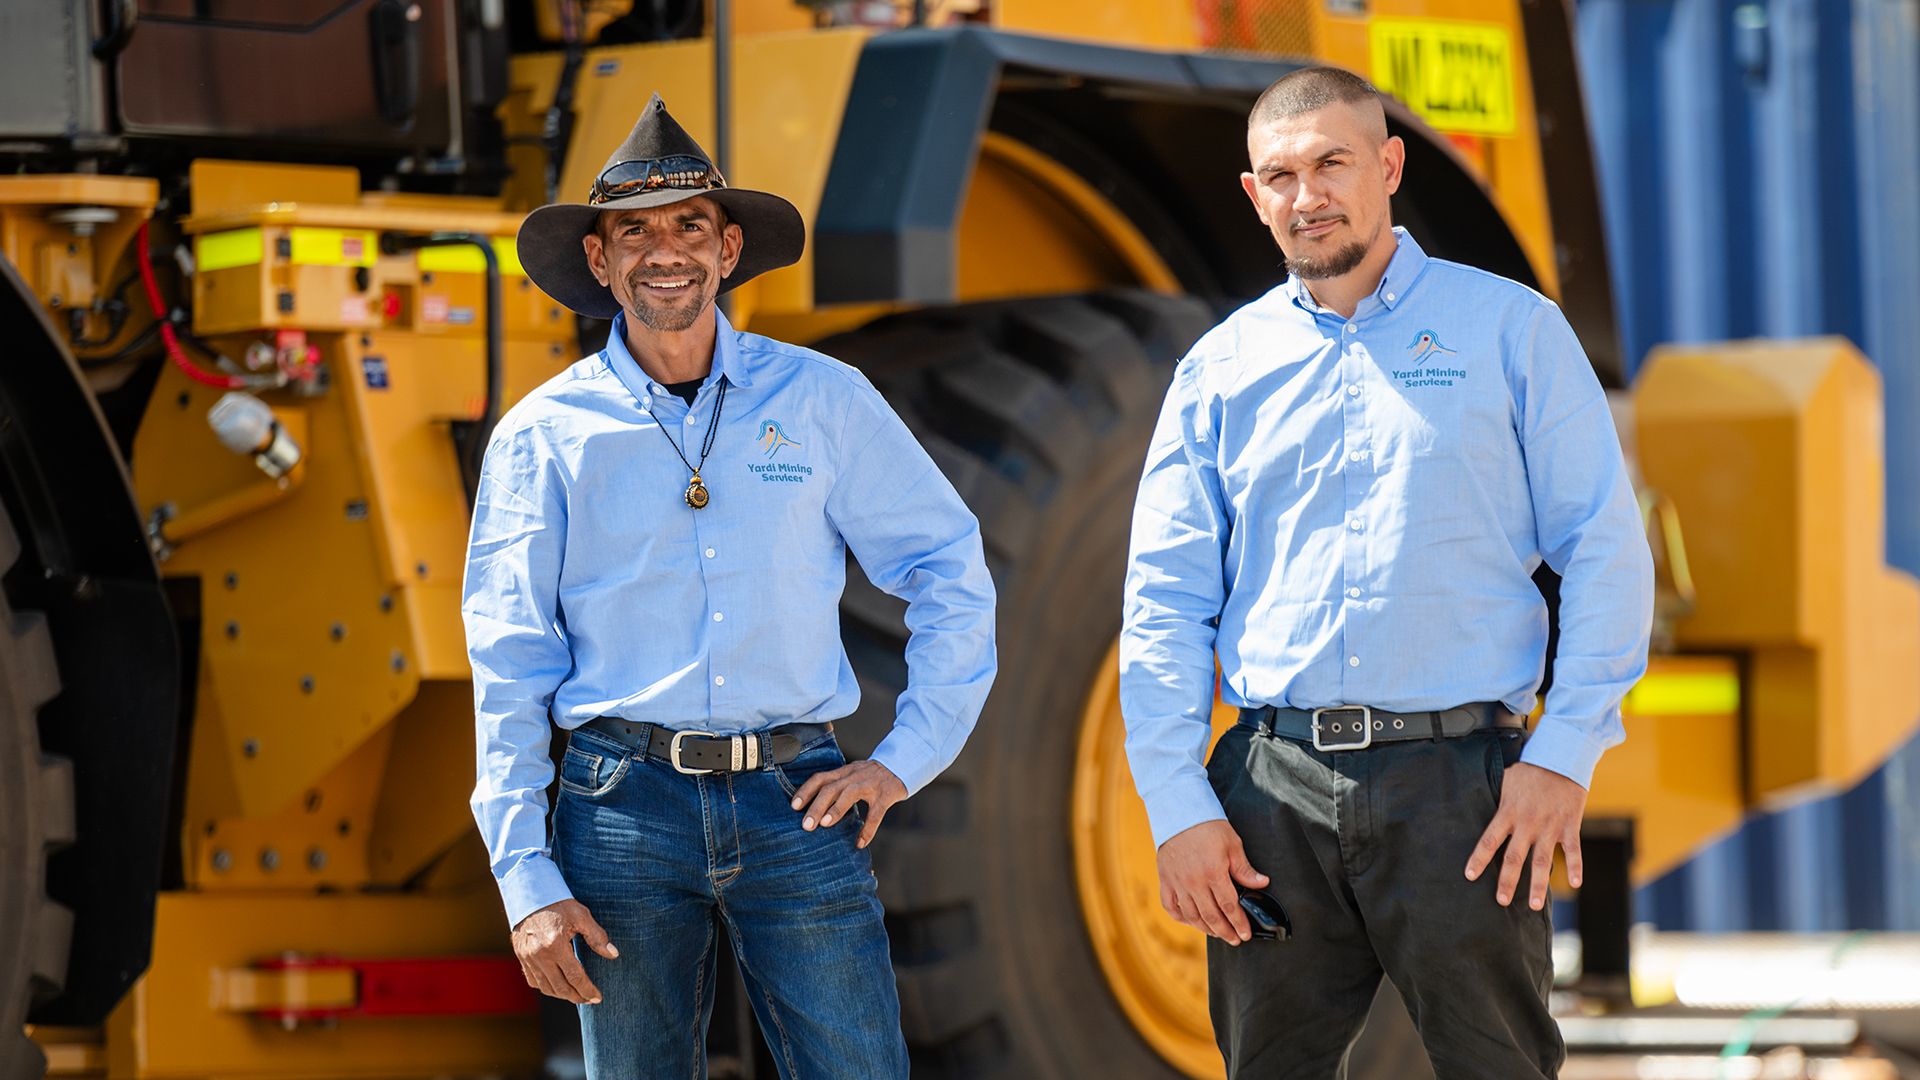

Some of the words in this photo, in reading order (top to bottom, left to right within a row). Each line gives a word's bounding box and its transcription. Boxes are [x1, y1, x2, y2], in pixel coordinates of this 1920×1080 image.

[1392, 368, 1423, 379] Yardi
[1426, 367, 1467, 379] Mining
[1405, 378, 1453, 388] Services
[747, 463, 776, 473] Yardi
[778, 463, 812, 475] Mining
[761, 473, 804, 482] Services
